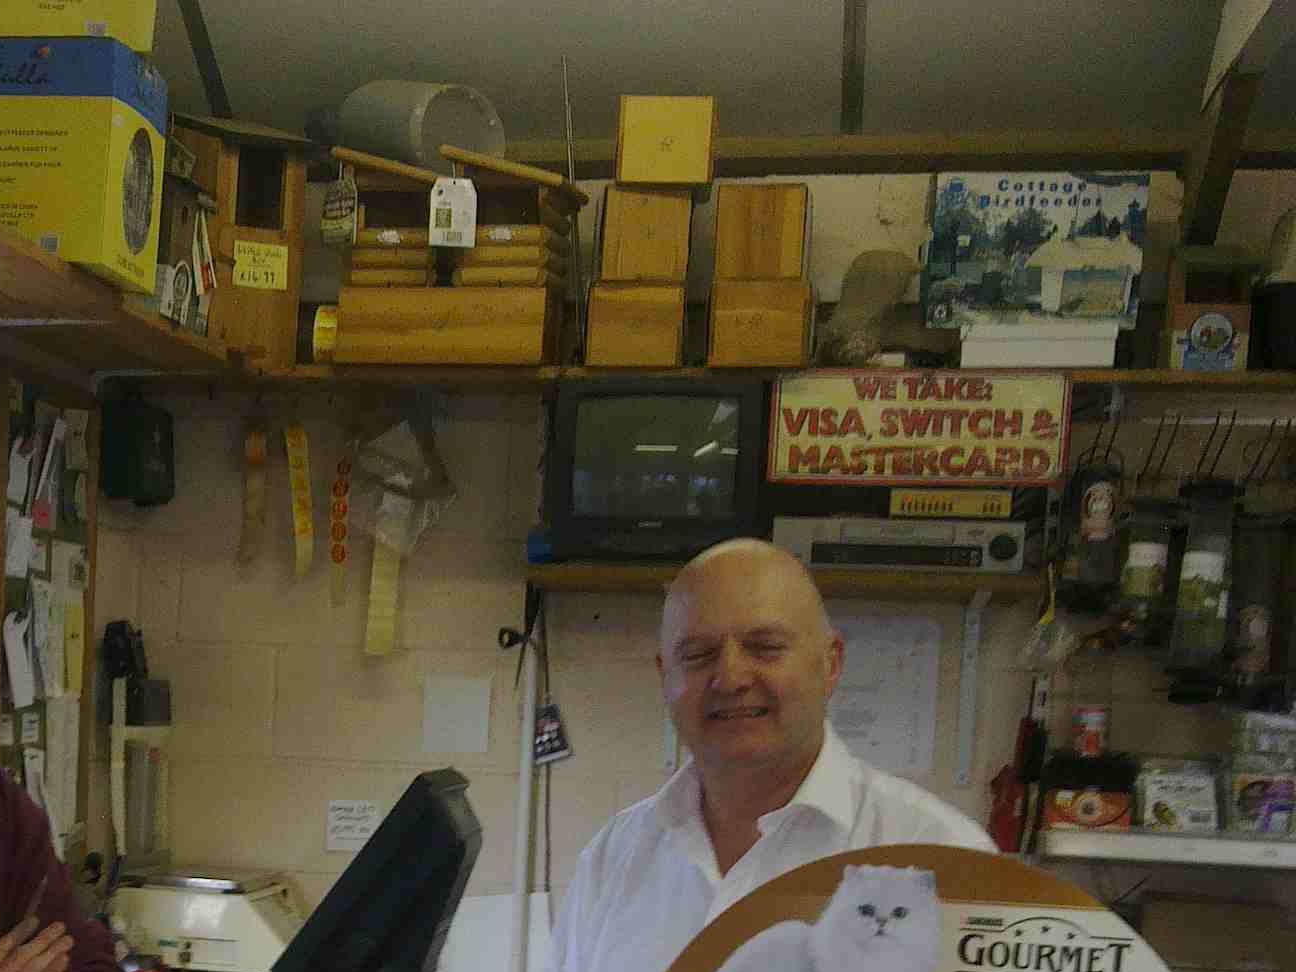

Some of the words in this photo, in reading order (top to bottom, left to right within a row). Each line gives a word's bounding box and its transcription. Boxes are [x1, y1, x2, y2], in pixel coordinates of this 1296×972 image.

[998, 179, 1088, 193] Cottage
[976, 194, 1103, 207] Birdfeeder
[853, 377, 897, 400] WE
[903, 377, 993, 400] TAKE:
[783, 408, 873, 440] VISA,
[880, 408, 1024, 439] SWITCH
[1032, 409, 1058, 440] &
[787, 445, 1051, 475] MASTERCARD
